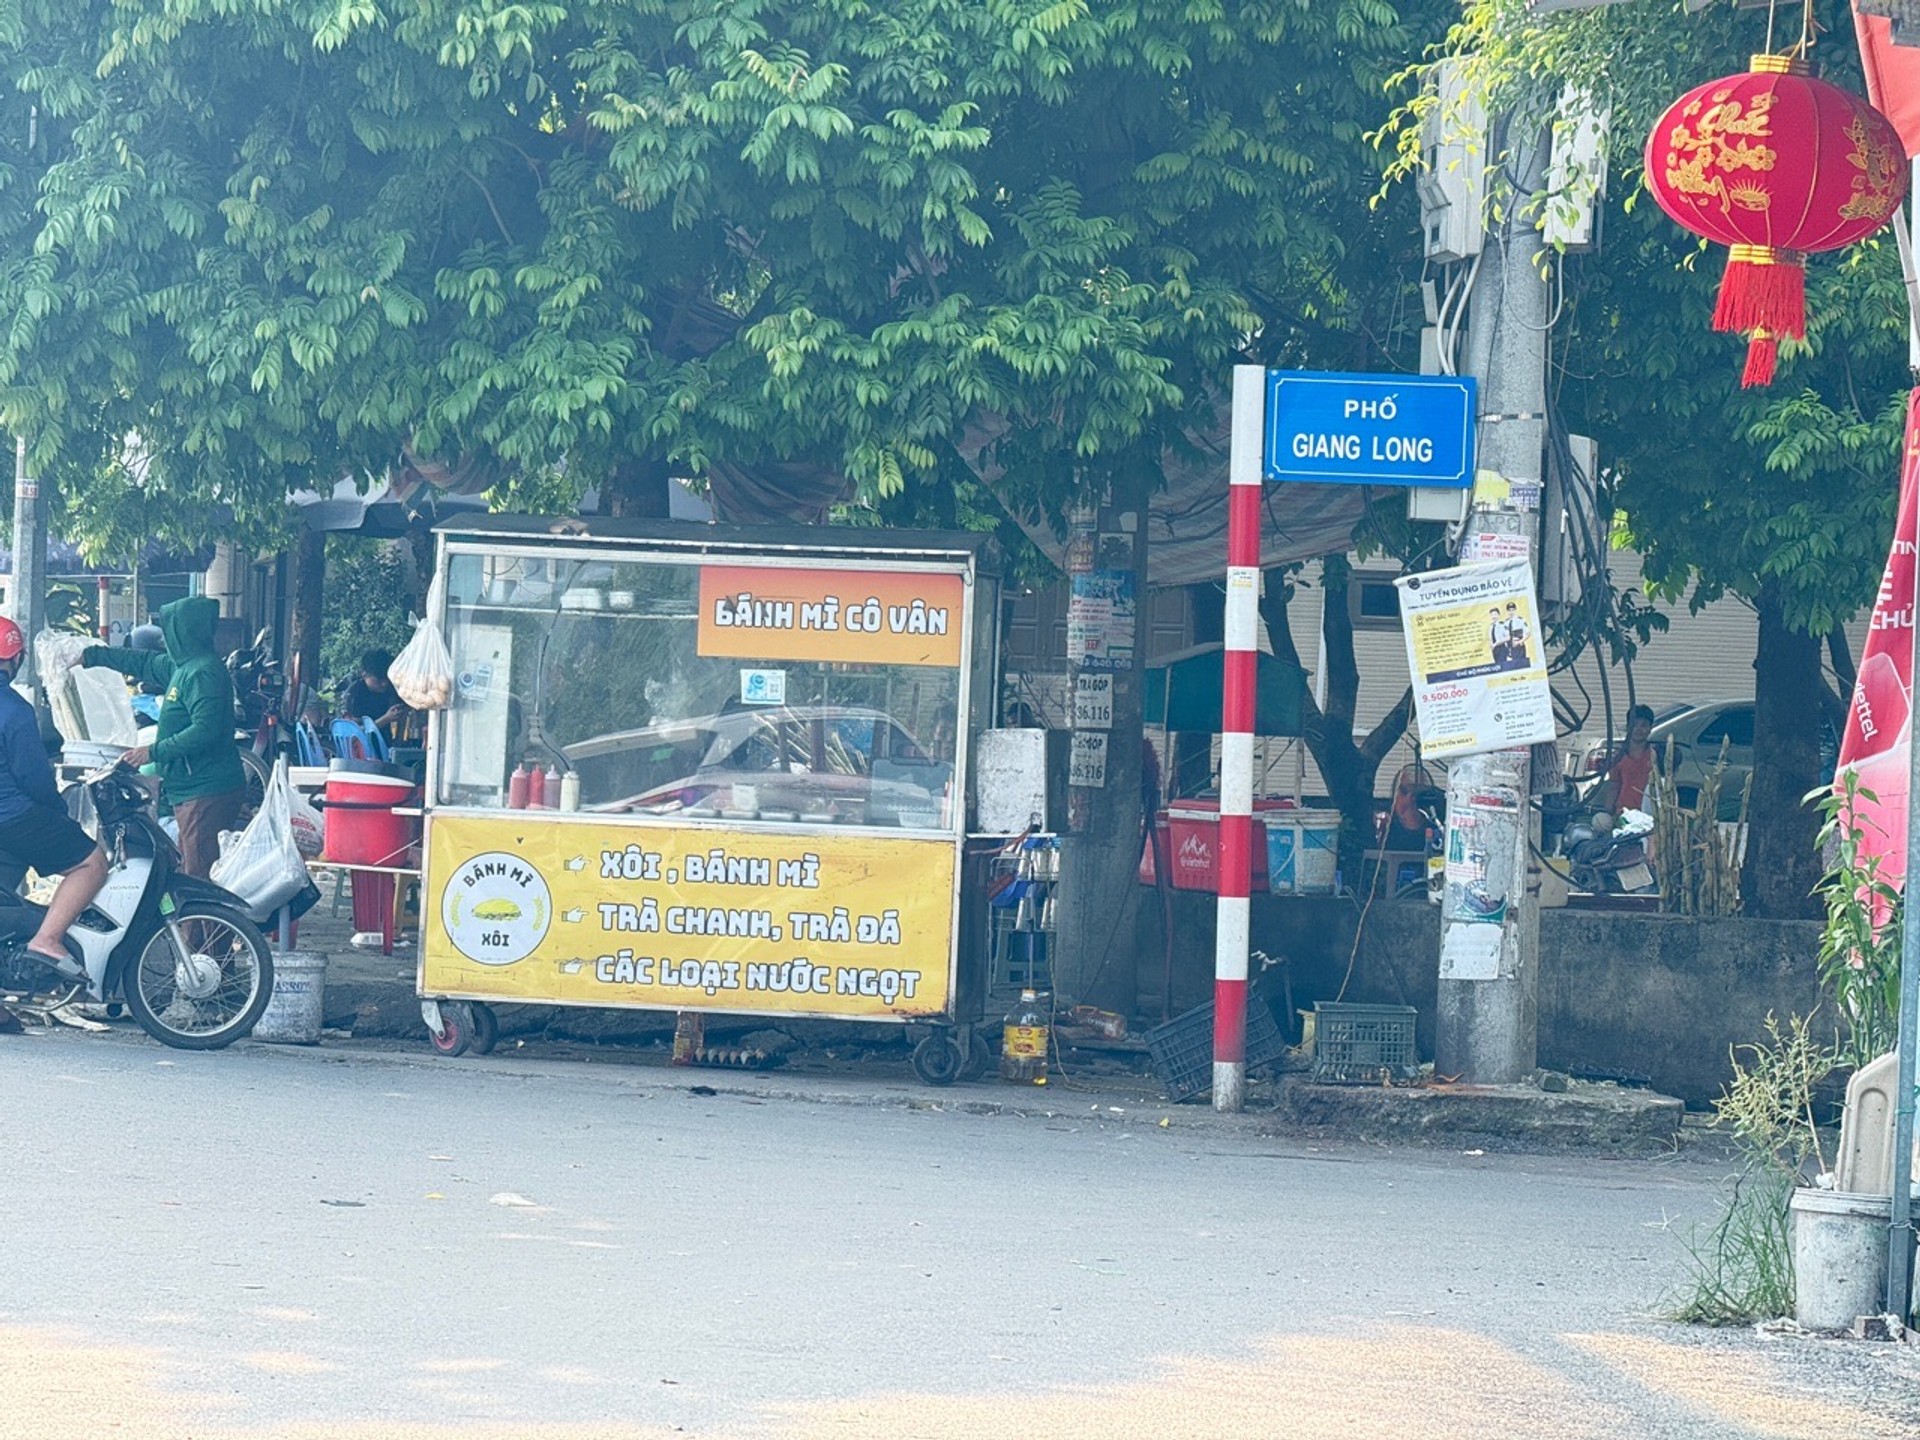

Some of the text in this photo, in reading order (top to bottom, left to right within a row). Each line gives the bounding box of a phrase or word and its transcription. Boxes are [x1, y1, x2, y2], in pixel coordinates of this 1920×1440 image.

[1344, 393, 1399, 420] PHỐ
[1292, 433, 1433, 463] GIANG LONG
[1419, 587, 1450, 601] TUYỂN
[1451, 585, 1479, 597] DỤNG
[1480, 579, 1499, 591] BẢO
[714, 592, 947, 635] BÁNH MÌ CÔ VÂN
[1422, 689, 1469, 703] 9.500.000
[463, 863, 534, 888] BÁNH MÌ
[600, 843, 662, 880] XÔI
[684, 848, 771, 886] BÁNH
[776, 852, 821, 889] MÌ
[598, 897, 901, 945] TRÀ CHANH, TRÀ ĐÁ
[481, 930, 509, 947] XÔI
[596, 948, 921, 1005] CÁC LOẠI NƯỚC NGỌT
